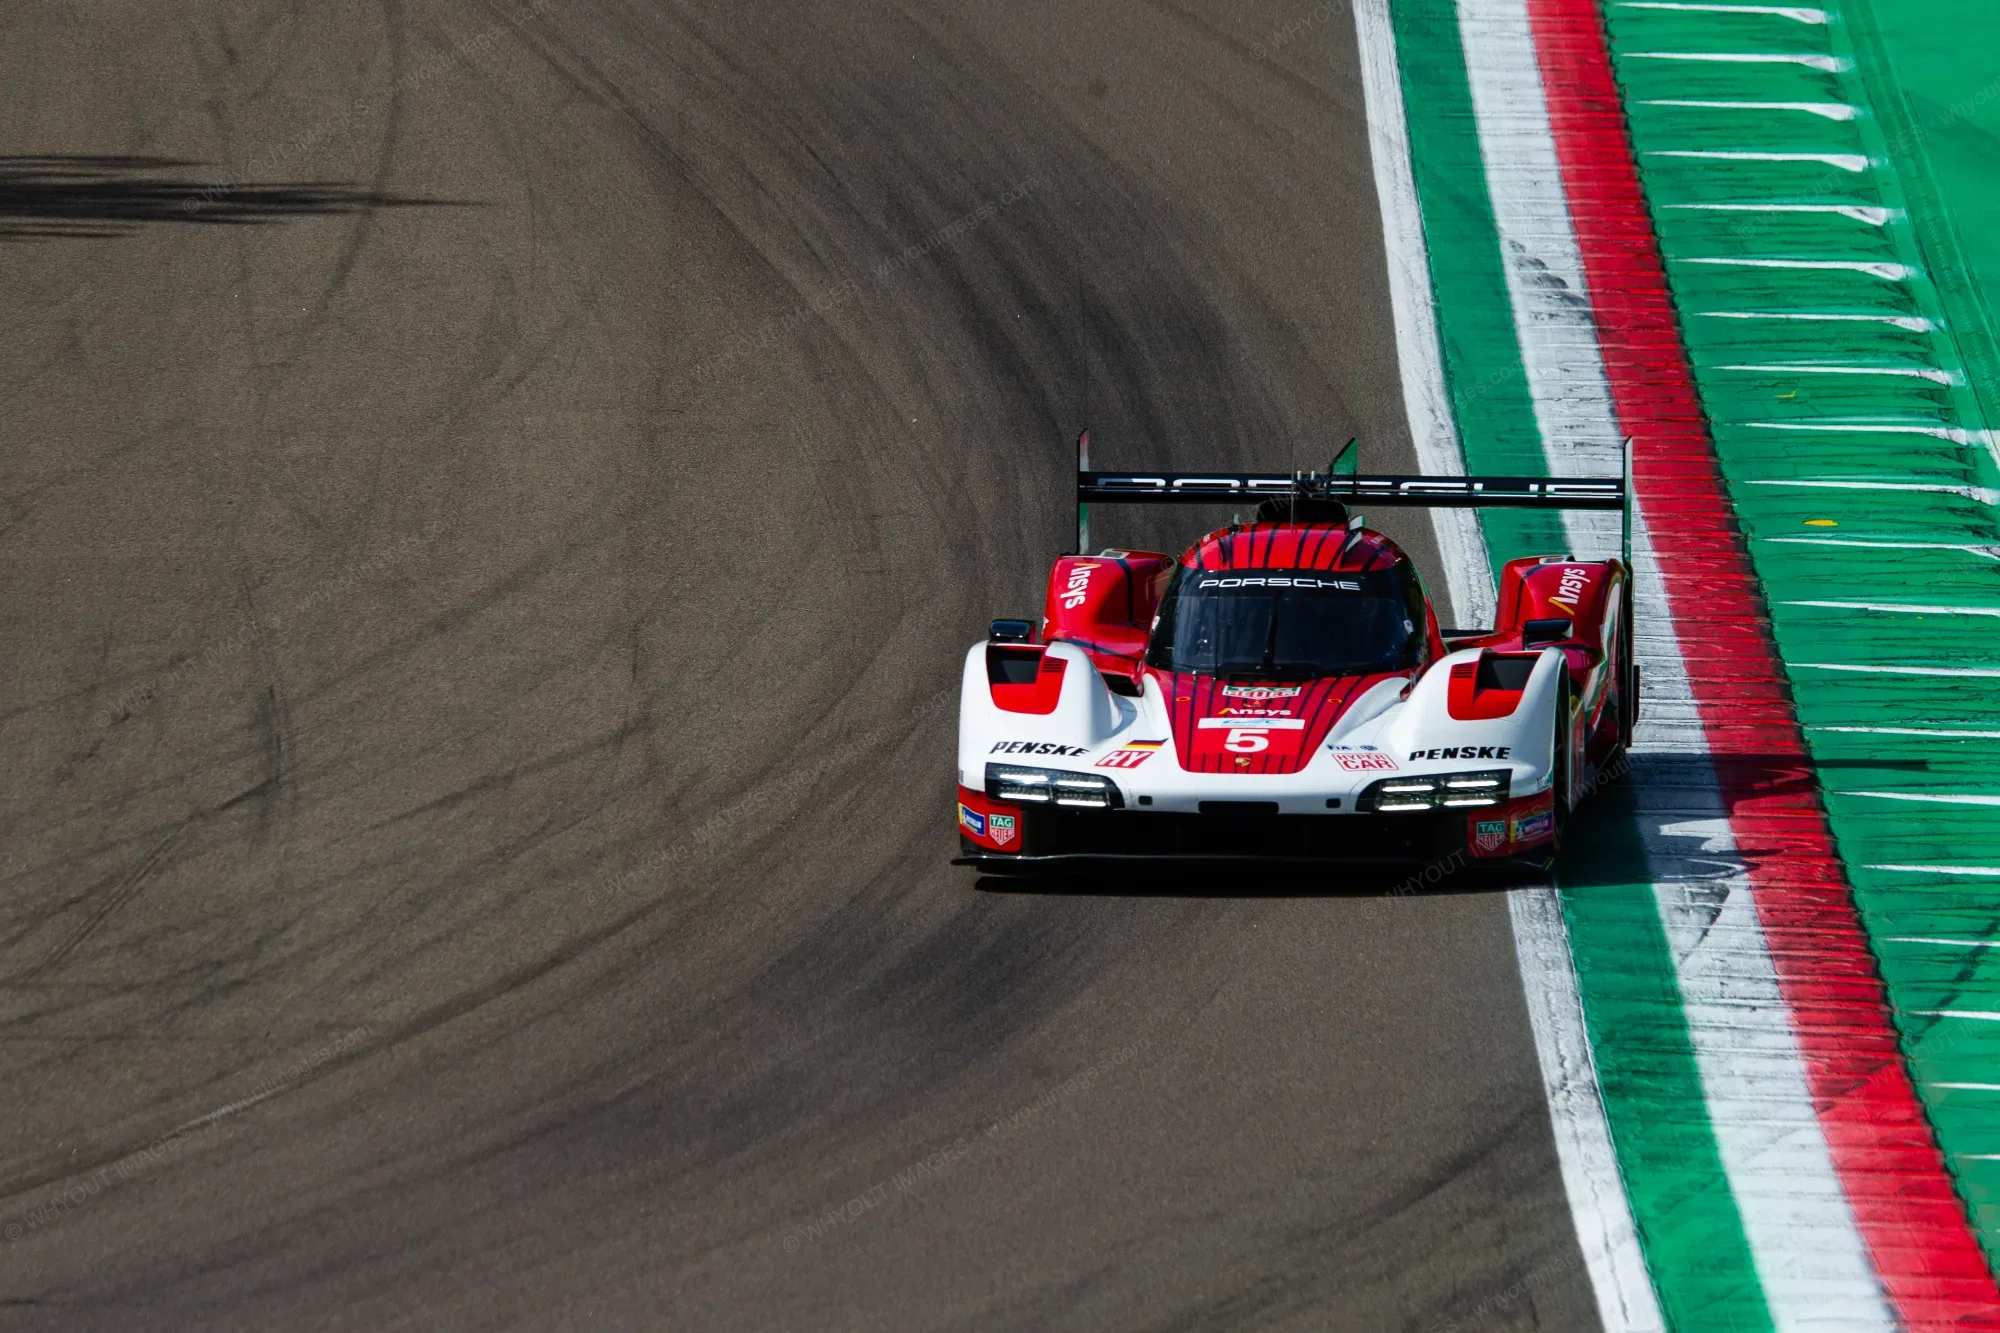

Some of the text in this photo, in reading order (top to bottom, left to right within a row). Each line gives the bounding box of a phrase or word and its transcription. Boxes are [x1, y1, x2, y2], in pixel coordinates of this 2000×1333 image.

[1060, 563, 1102, 609] Ansys
[1199, 578, 1361, 591] PORSCHE
[1548, 568, 1590, 616] Ansys
[1218, 707, 1291, 716] Ansys
[1224, 729, 1269, 753] 5
[989, 741, 1090, 757] PENSKE
[1409, 746, 1511, 761] PENSKE
[1098, 751, 1151, 767] HY
[1343, 759, 1393, 769] CAR
[992, 817, 1012, 827] TAG
[1479, 823, 1503, 832] TAG
[990, 828, 1013, 844] HEUER
